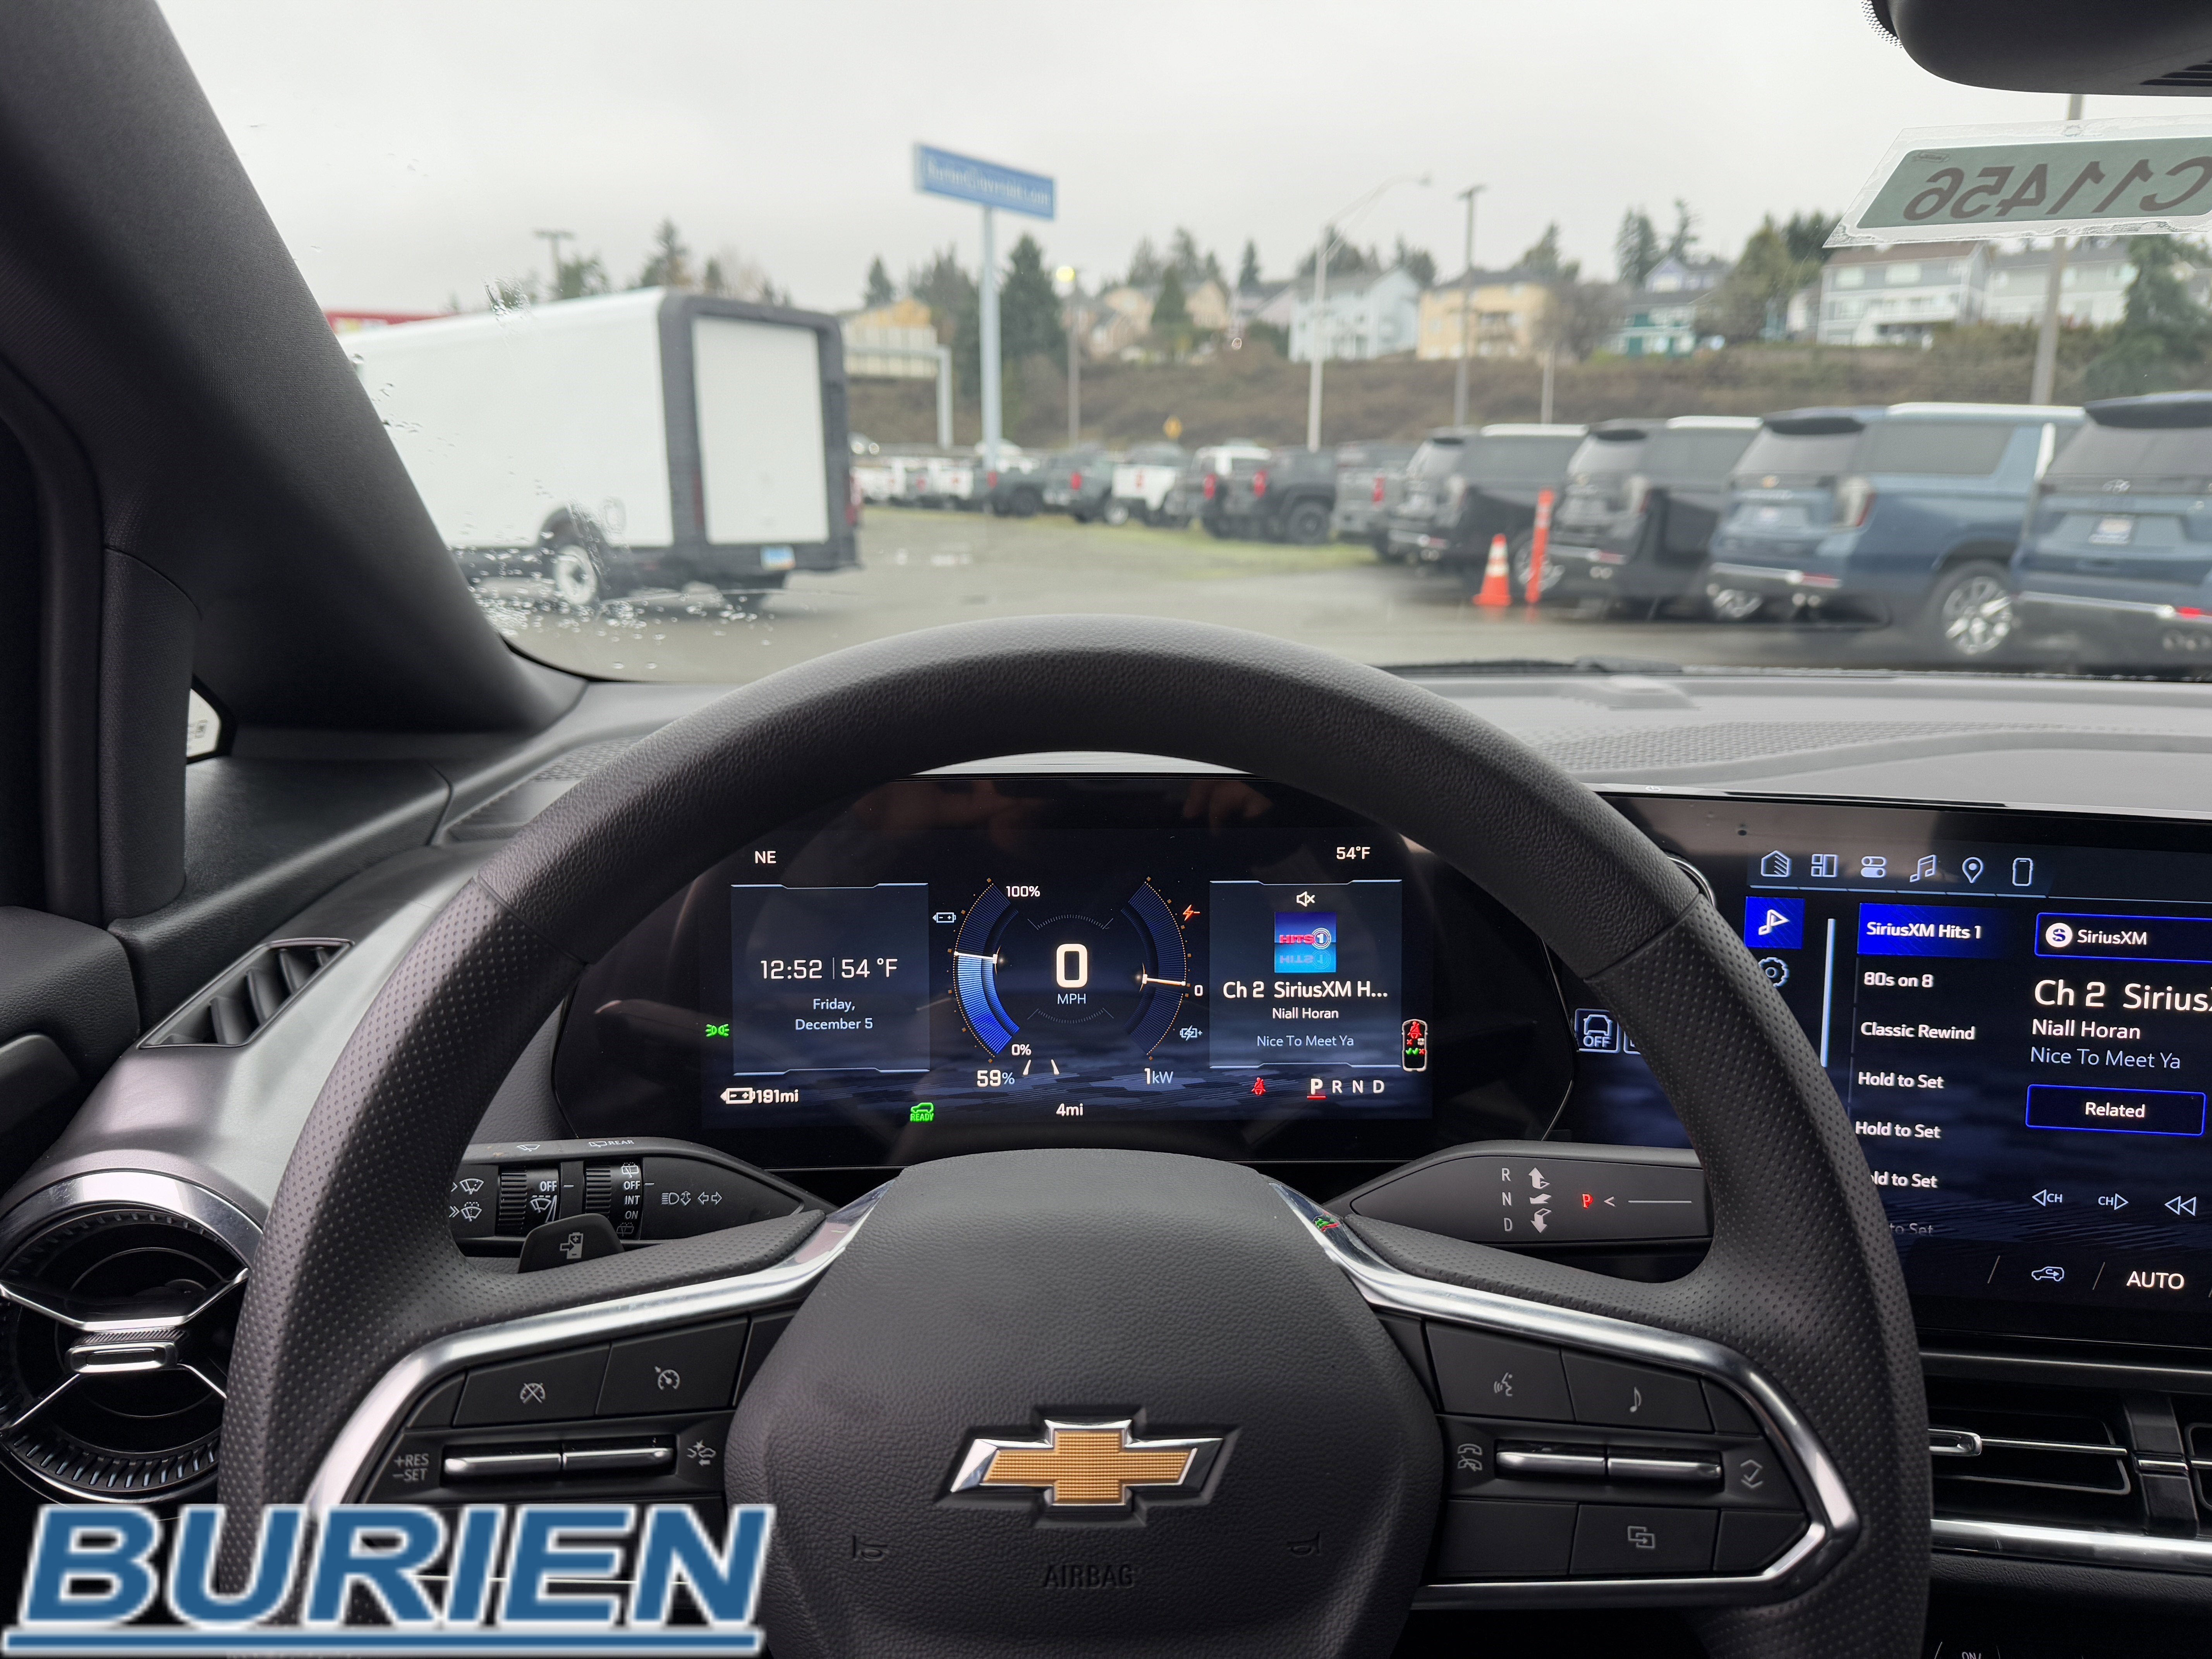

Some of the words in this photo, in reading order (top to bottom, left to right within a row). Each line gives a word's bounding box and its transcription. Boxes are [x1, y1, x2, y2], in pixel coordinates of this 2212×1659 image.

[755, 851, 776, 863] NE
[1337, 846, 1370, 859] 54°F
[1006, 886, 1040, 897] 100%
[1867, 922, 1935, 937] SiriusXM
[1939, 924, 1970, 938] Hits
[1974, 925, 1981, 939] 1
[2078, 929, 2147, 945] SiriusXM
[1279, 934, 1314, 944] HITS
[761, 960, 822, 979] 12:52
[842, 959, 870, 978] 54
[1056, 944, 1087, 988] 0
[1864, 972, 1895, 986] 80s
[1898, 977, 1918, 987] on
[1922, 974, 1933, 988] 8
[1195, 985, 1203, 996] 0
[1223, 981, 1247, 998] Ch
[1253, 981, 1264, 998] 2
[1274, 981, 1351, 998] SiriusXM
[2035, 979, 2074, 1005] Ch
[2086, 982, 2105, 1007] 2
[2123, 983, 2212, 1012] Sirius
[814, 998, 855, 1012] Friday,
[1058, 994, 1086, 1004] MPH
[1273, 1007, 1298, 1018] Niall
[1302, 1008, 1338, 1018] Horan
[796, 1018, 860, 1030] December
[865, 1018, 872, 1029] 5
[1861, 1022, 1914, 1037] Classic
[1918, 1025, 1975, 1039] Rewind
[2033, 1019, 2075, 1036] Niall
[2081, 1021, 2140, 1039] Horan
[1257, 1036, 1283, 1046] Nice
[1286, 1036, 1302, 1046] To
[1306, 1036, 1337, 1046] Meet
[1340, 1036, 1353, 1046] Ya
[1583, 1036, 1611, 1048] OFF
[1012, 1044, 1031, 1055] 0%
[2031, 1047, 2071, 1064] Nice
[2077, 1049, 2099, 1065] To
[2106, 1050, 2155, 1067] Meet
[2160, 1053, 2180, 1068] Ya
[977, 1070, 1015, 1087] 59%
[1145, 1068, 1173, 1084] 1kW
[1858, 1072, 1895, 1086] Hold
[1898, 1075, 1915, 1087] to
[1918, 1075, 1944, 1088] Set
[1311, 1079, 1322, 1094] P
[1333, 1080, 1342, 1093] R
[1353, 1080, 1363, 1093] N
[1373, 1080, 1384, 1093] D
[756, 1089, 798, 1103] 191mi
[1056, 1103, 1083, 1116] 4mi
[2085, 1102, 2145, 1118] Related
[910, 1113, 934, 1122] READY
[1856, 1121, 1892, 1135] Hold
[1894, 1125, 1911, 1137] to
[1915, 1124, 1940, 1138] Set
[1502, 1168, 1510, 1181] R
[1870, 1171, 1889, 1185] ld
[1891, 1174, 1908, 1186] to
[1911, 1174, 1937, 1188] Set
[540, 1180, 556, 1191] OFF
[623, 1181, 640, 1190] OFF
[625, 1195, 640, 1204] INT
[1502, 1192, 1511, 1206] N
[1582, 1194, 1593, 1208] P
[2047, 1194, 2062, 1202] CH
[2098, 1196, 2113, 1205] CH
[625, 1211, 638, 1219] ON
[1504, 1218, 1512, 1231] D
[2126, 1271, 2184, 1289] AUTO
[1045, 1565, 1135, 1588] AIRBAG
